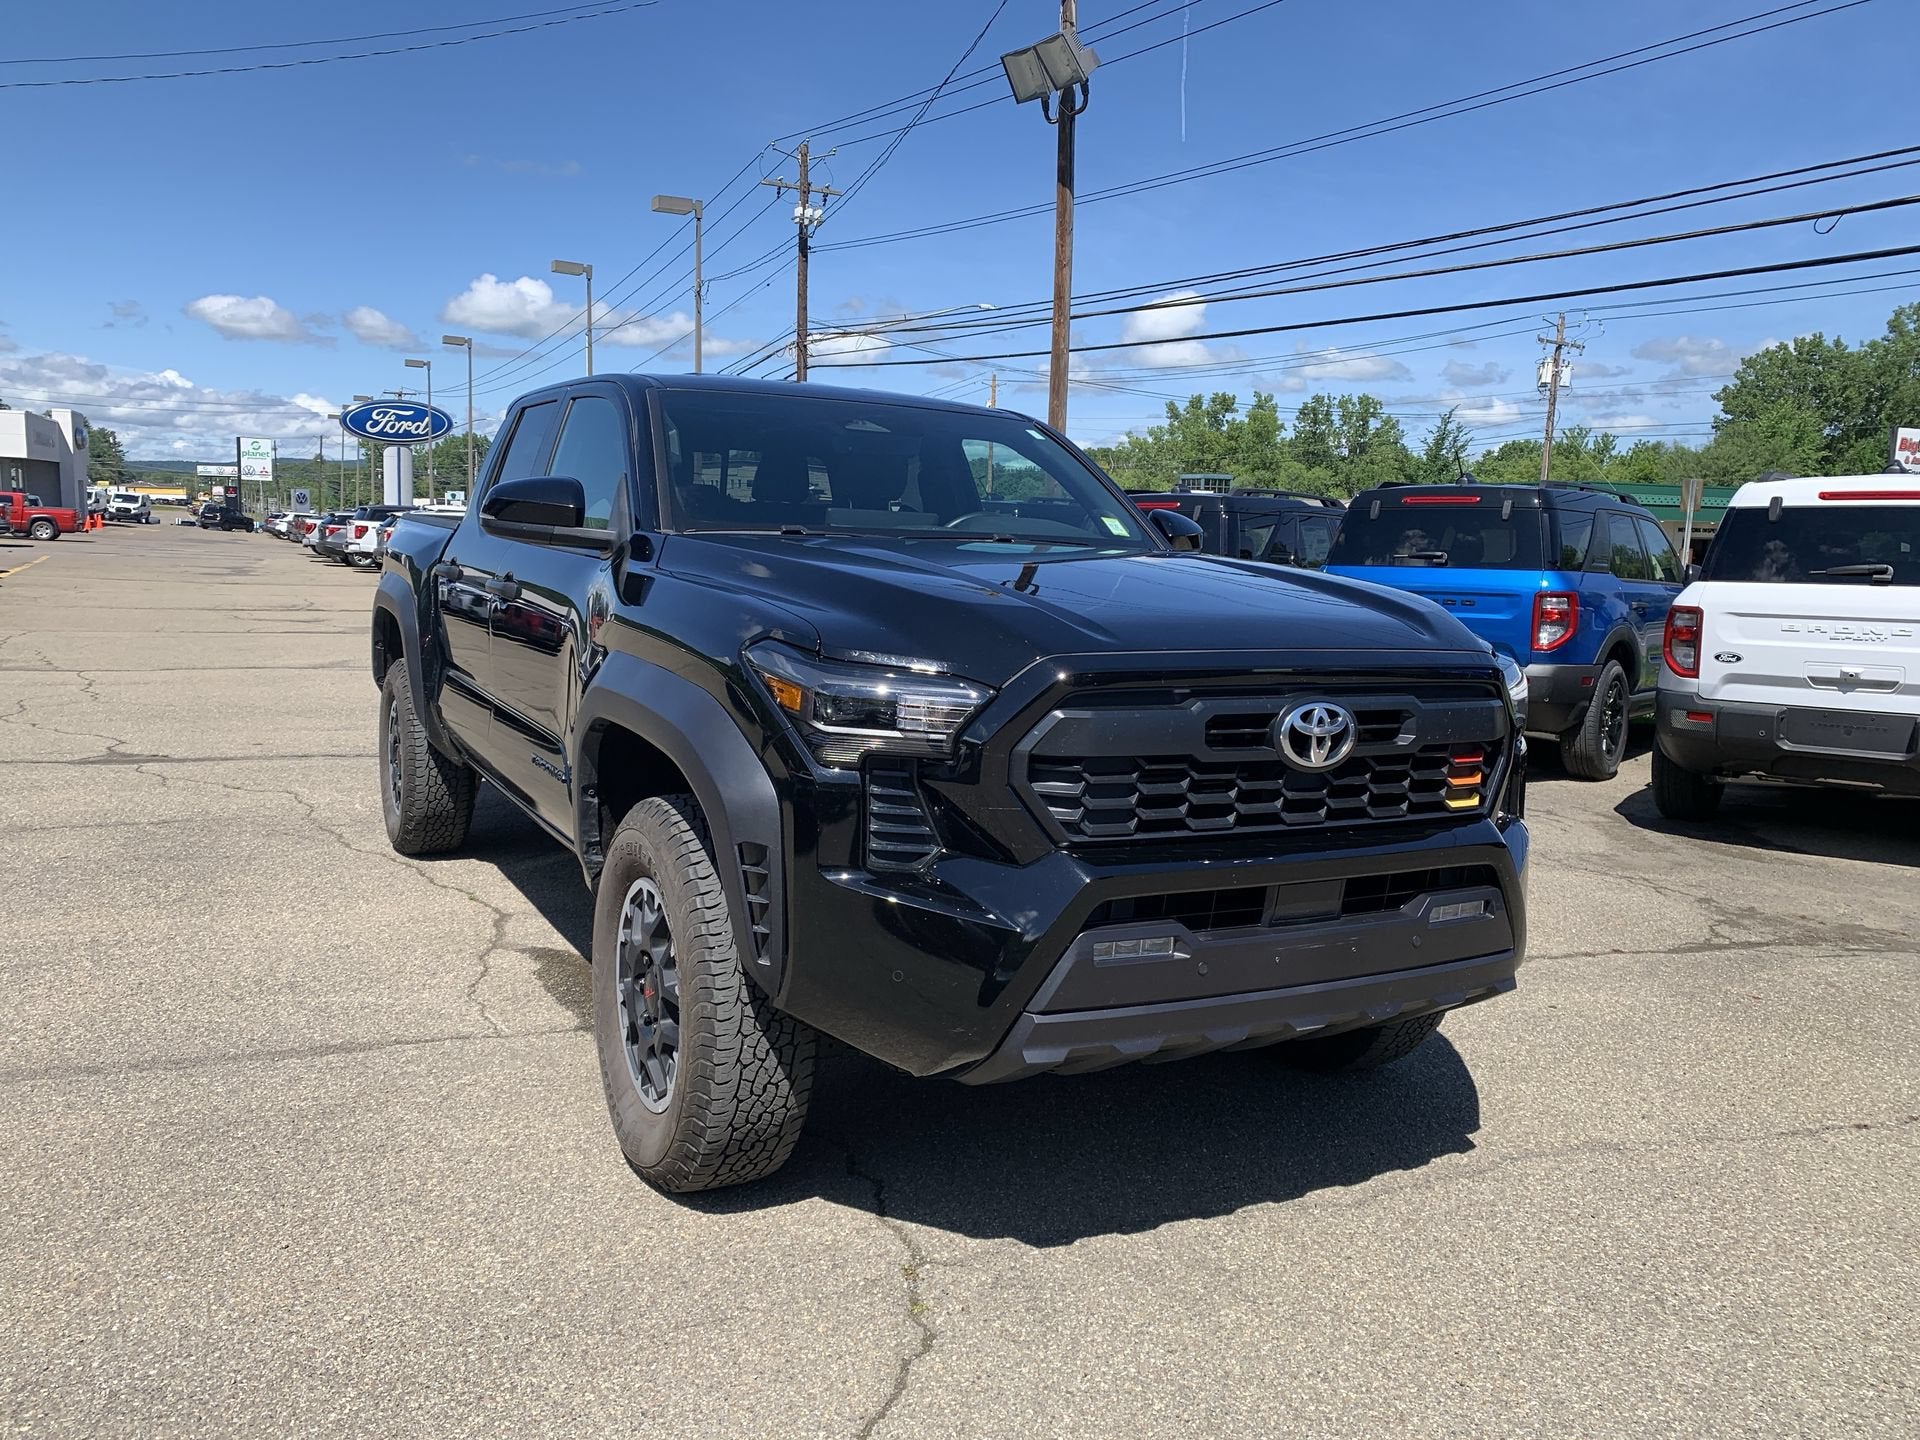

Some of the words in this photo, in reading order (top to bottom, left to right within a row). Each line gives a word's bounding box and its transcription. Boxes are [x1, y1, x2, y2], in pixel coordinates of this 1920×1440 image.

[365, 408, 430, 434] Ford
[242, 449, 270, 458] planet
[1718, 653, 1738, 663] Ford
